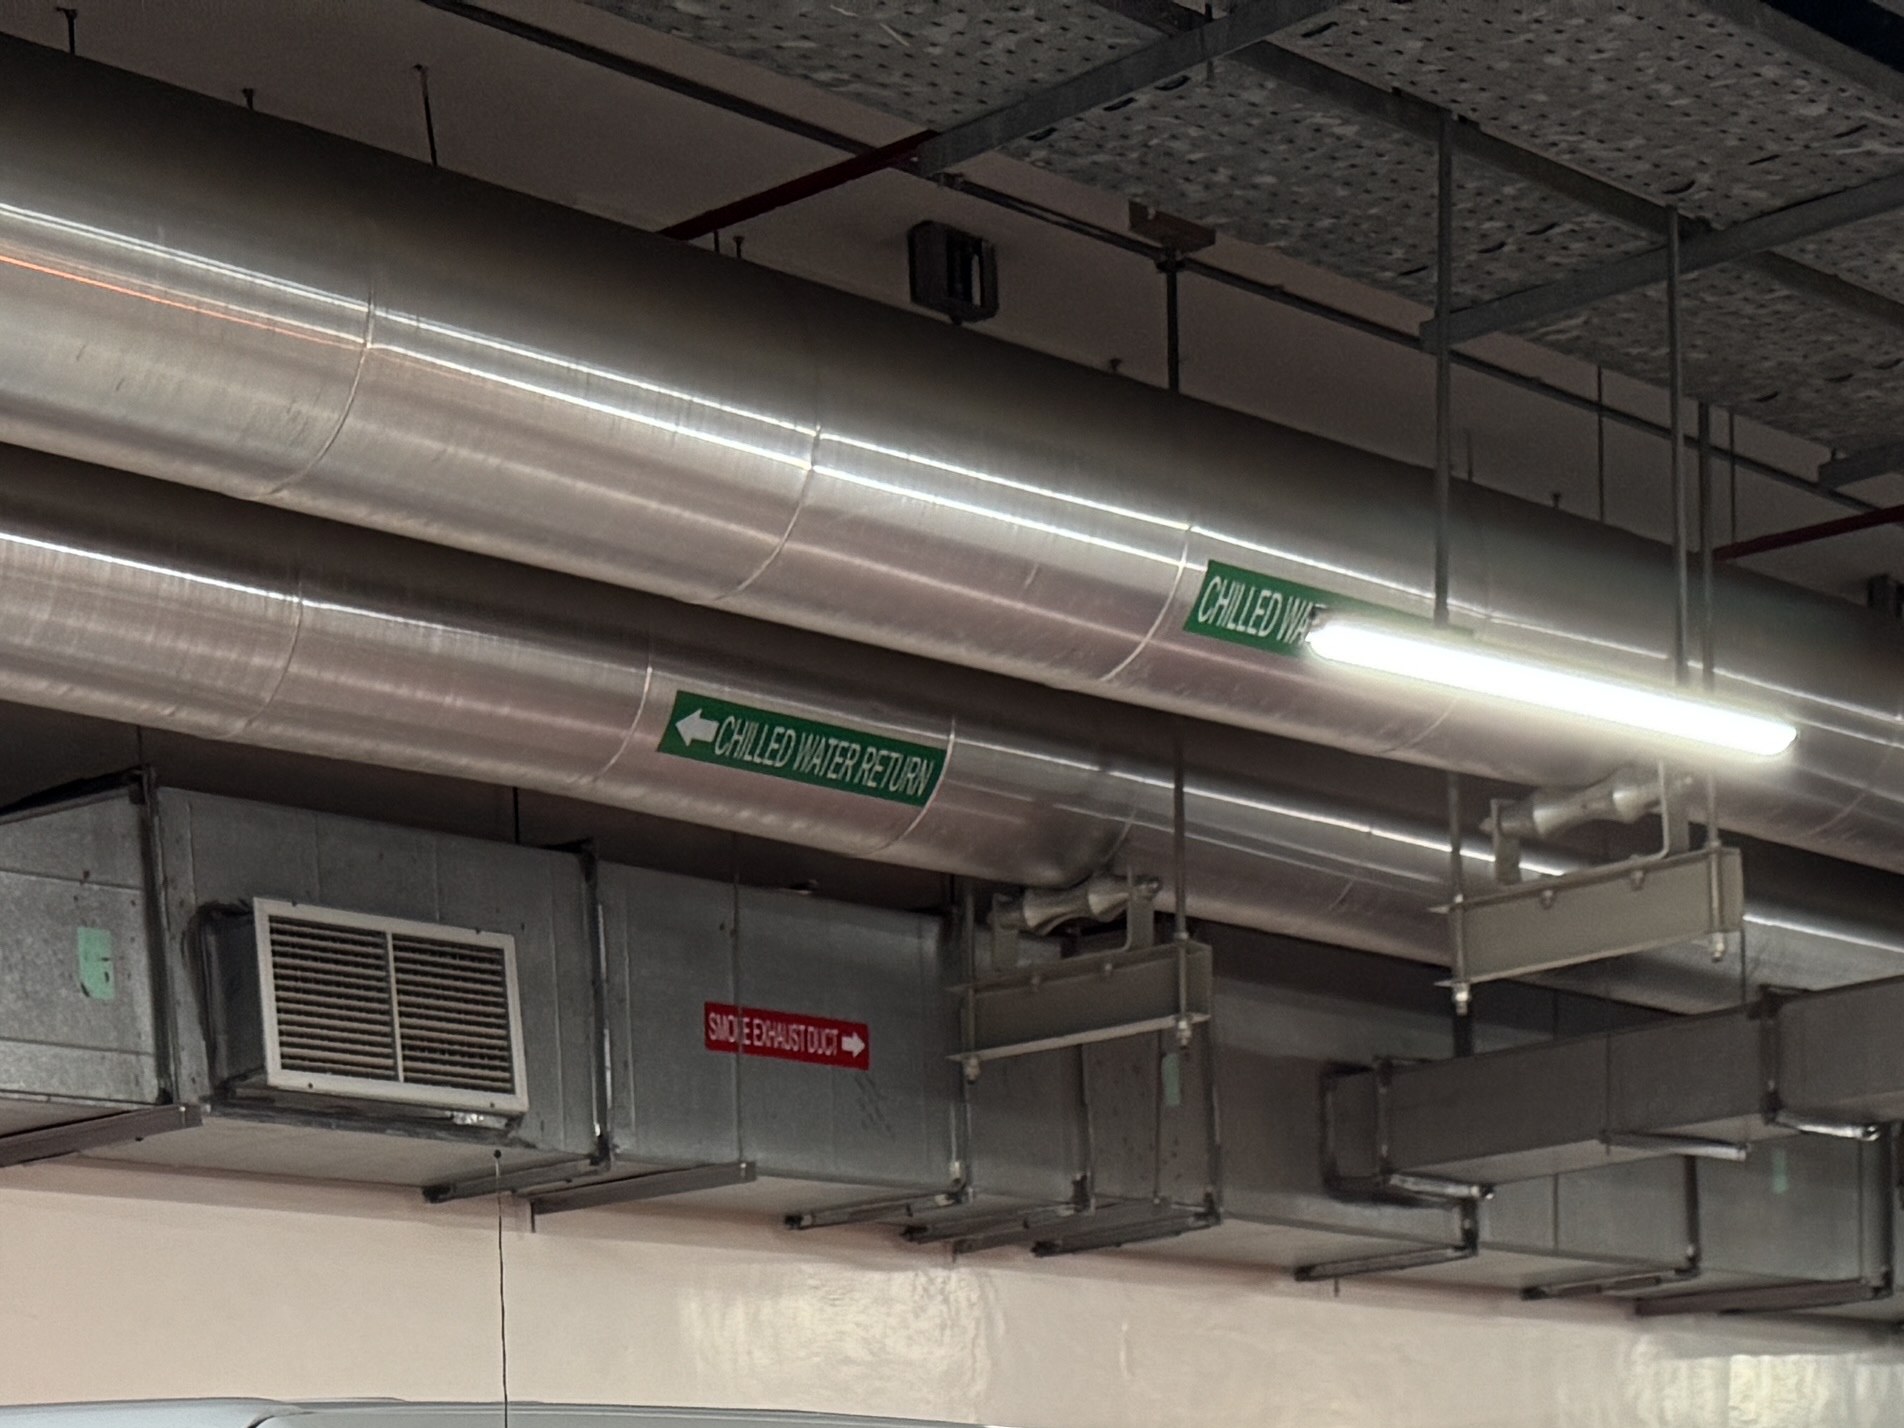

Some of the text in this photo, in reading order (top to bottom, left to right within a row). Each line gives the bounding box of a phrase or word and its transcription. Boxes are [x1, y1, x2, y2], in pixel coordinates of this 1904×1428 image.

[1197, 575, 1283, 638] CHILLED
[714, 715, 936, 797] CHILLED WATER RETURN
[707, 1012, 839, 1056] SMOE EXHAUST DUCT
